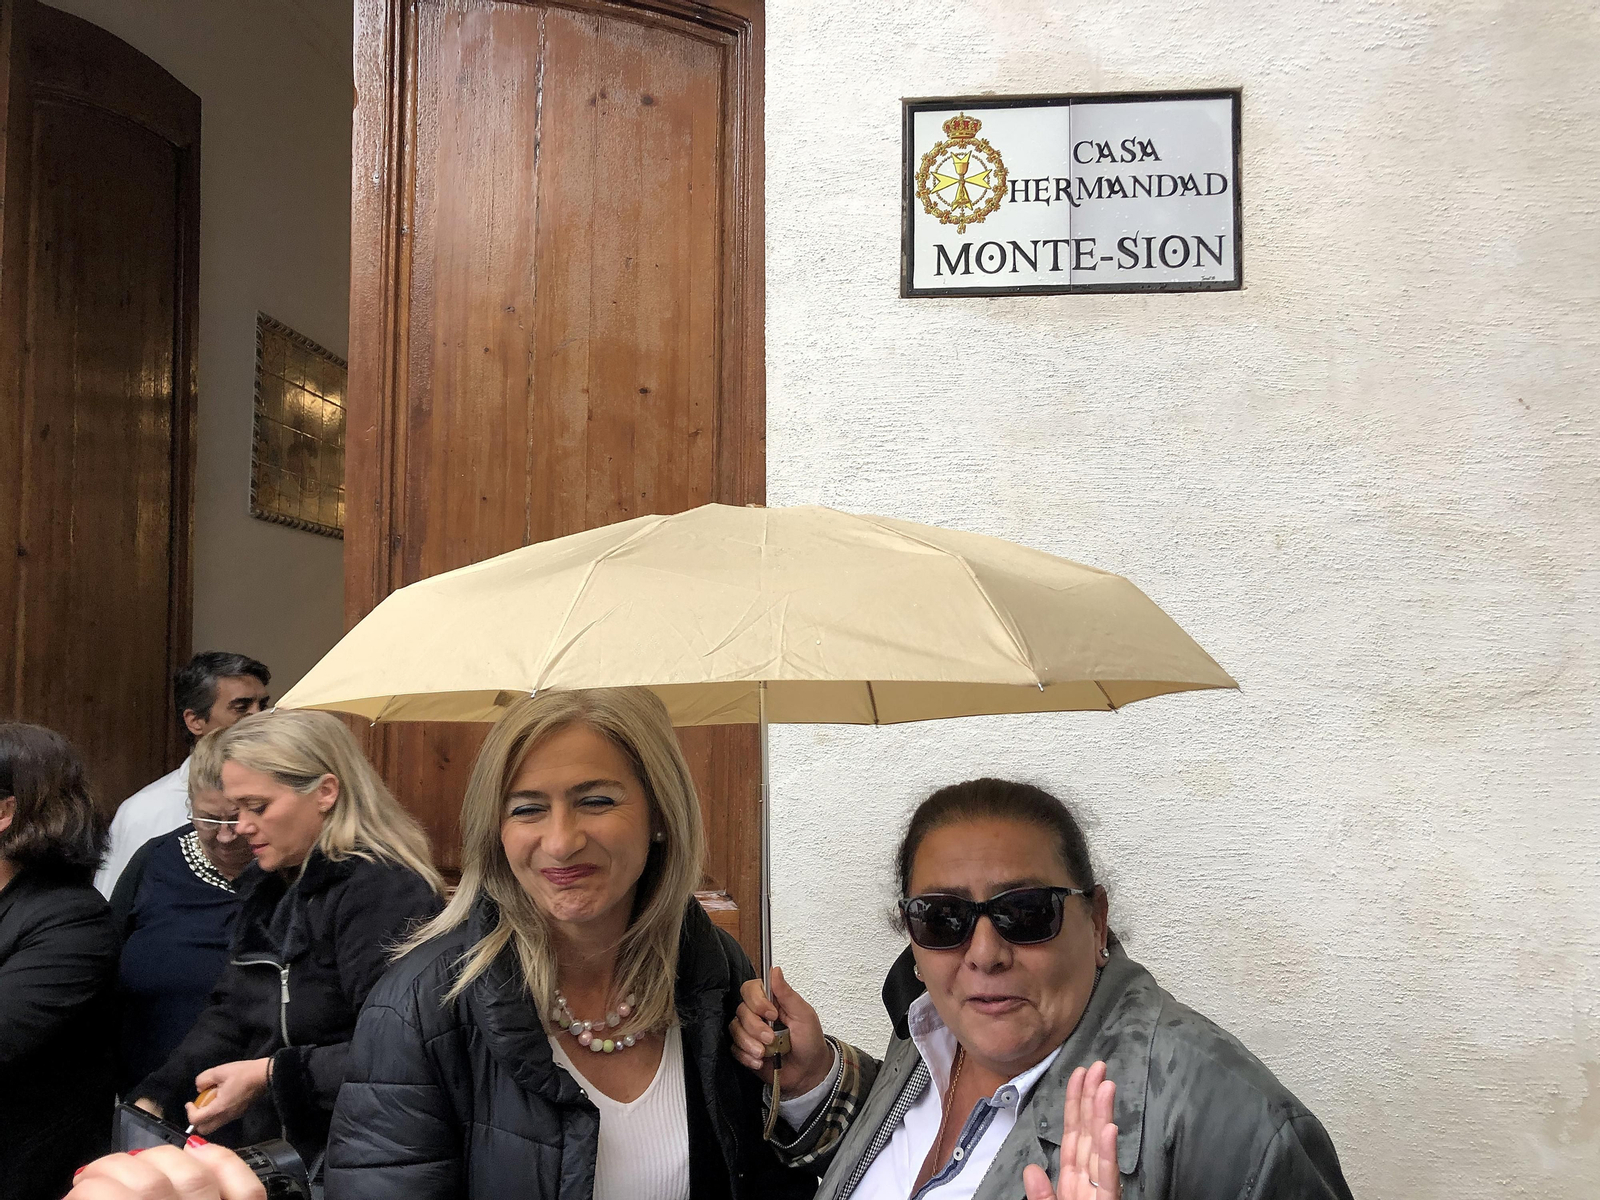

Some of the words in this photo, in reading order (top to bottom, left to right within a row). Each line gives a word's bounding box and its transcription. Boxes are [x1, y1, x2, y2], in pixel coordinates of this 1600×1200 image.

[1073, 136, 1162, 164] CASA
[1009, 173, 1228, 207] HERMANDAD
[933, 231, 1226, 276] MONTE-SION
